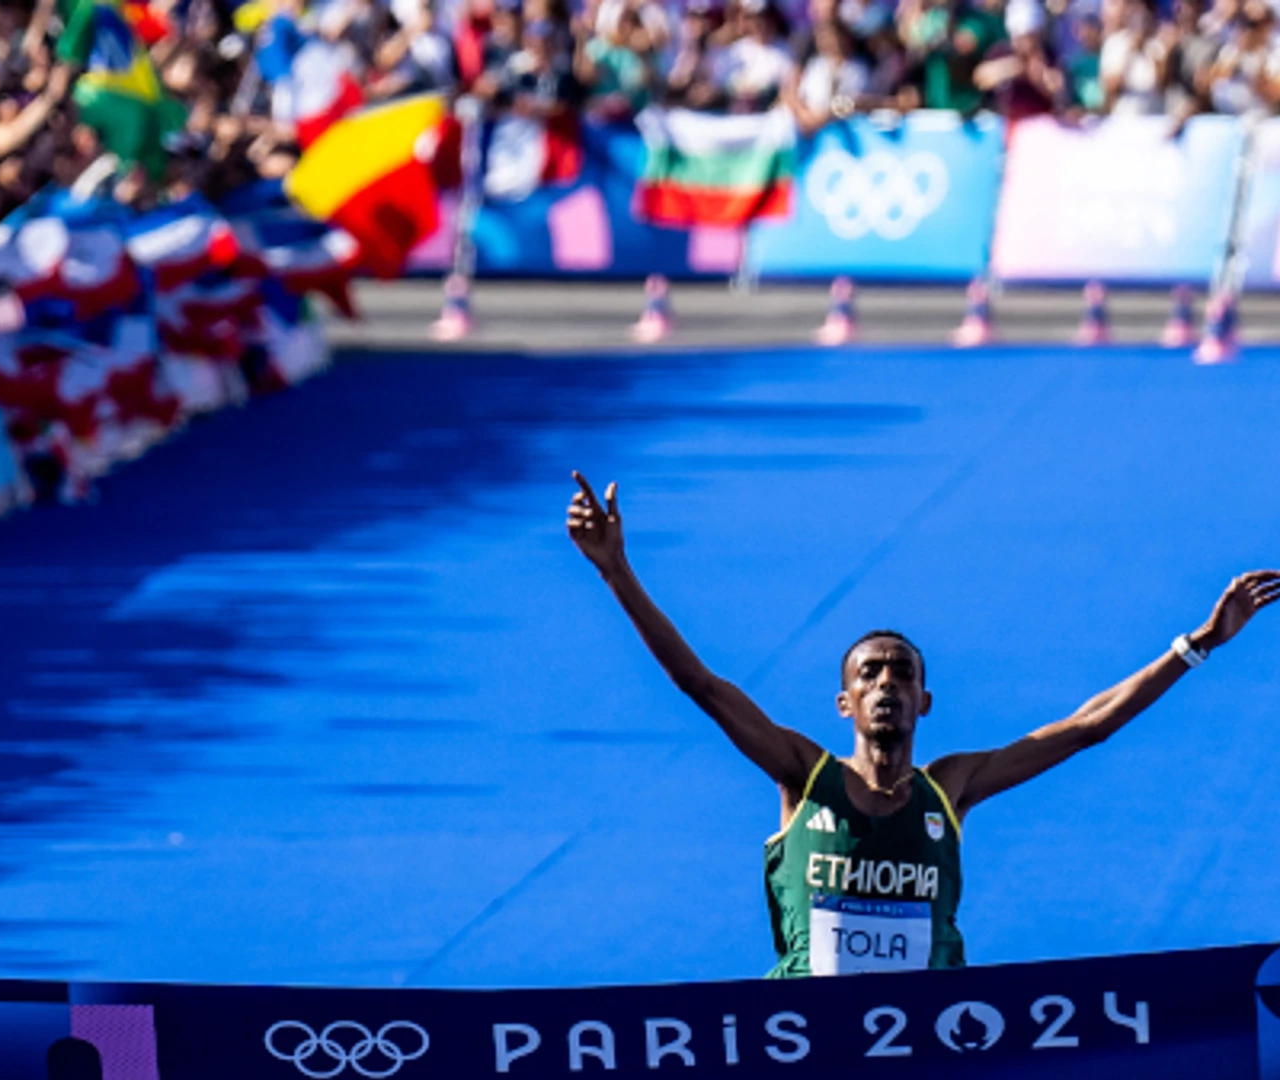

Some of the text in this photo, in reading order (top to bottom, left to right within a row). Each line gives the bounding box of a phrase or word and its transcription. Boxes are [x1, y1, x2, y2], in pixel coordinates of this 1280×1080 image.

[806, 852, 939, 900] ETHIOPIA
[831, 926, 909, 961] TOLA
[863, 992, 1150, 1058] 2024
